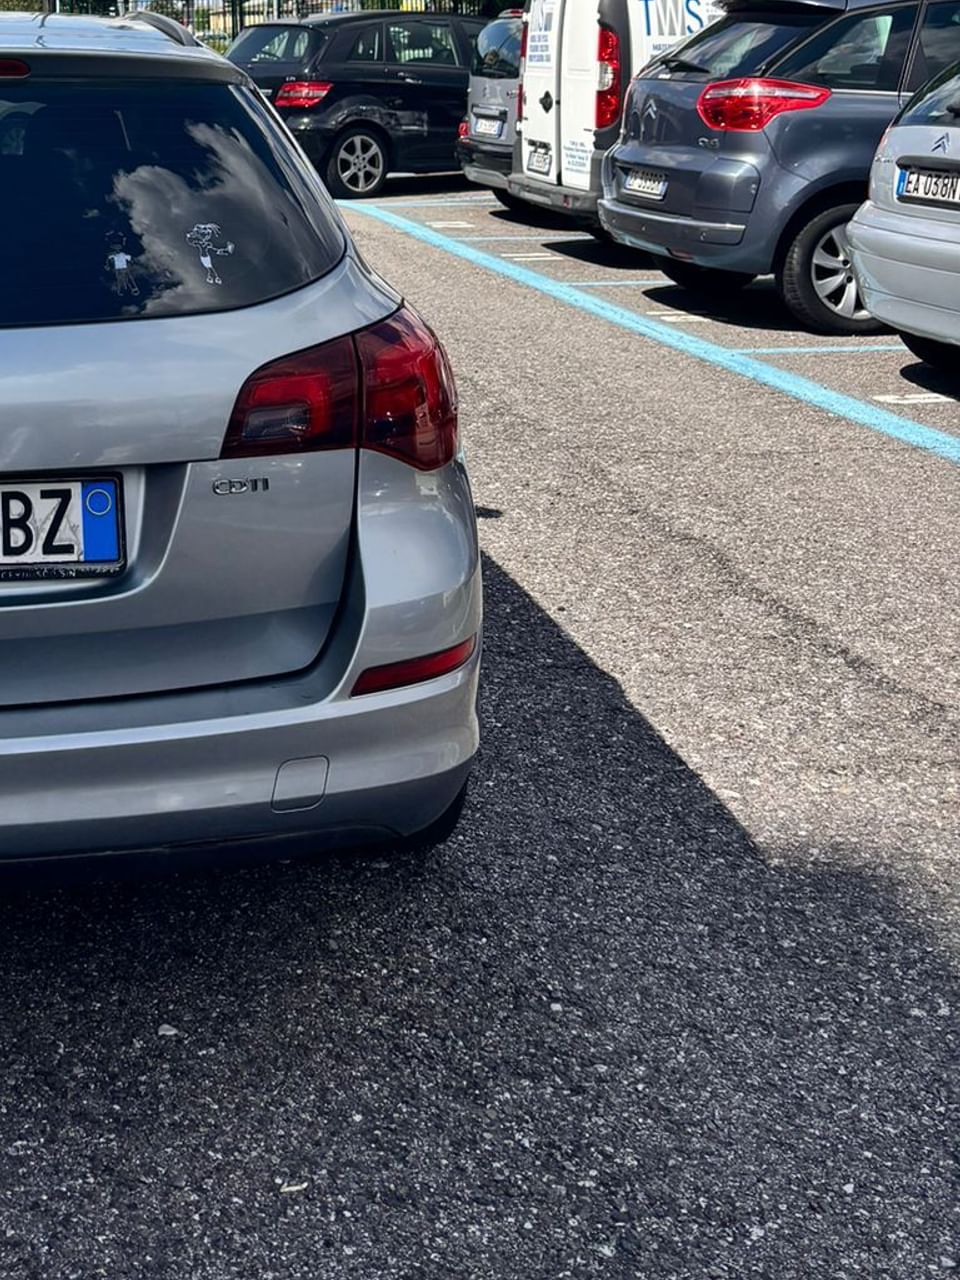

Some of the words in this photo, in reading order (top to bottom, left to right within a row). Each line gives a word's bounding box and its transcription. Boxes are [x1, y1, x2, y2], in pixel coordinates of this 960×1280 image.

[904, 170, 920, 194] EA
[924, 172, 960, 201] 038N
[212, 477, 269, 495] CDTI
